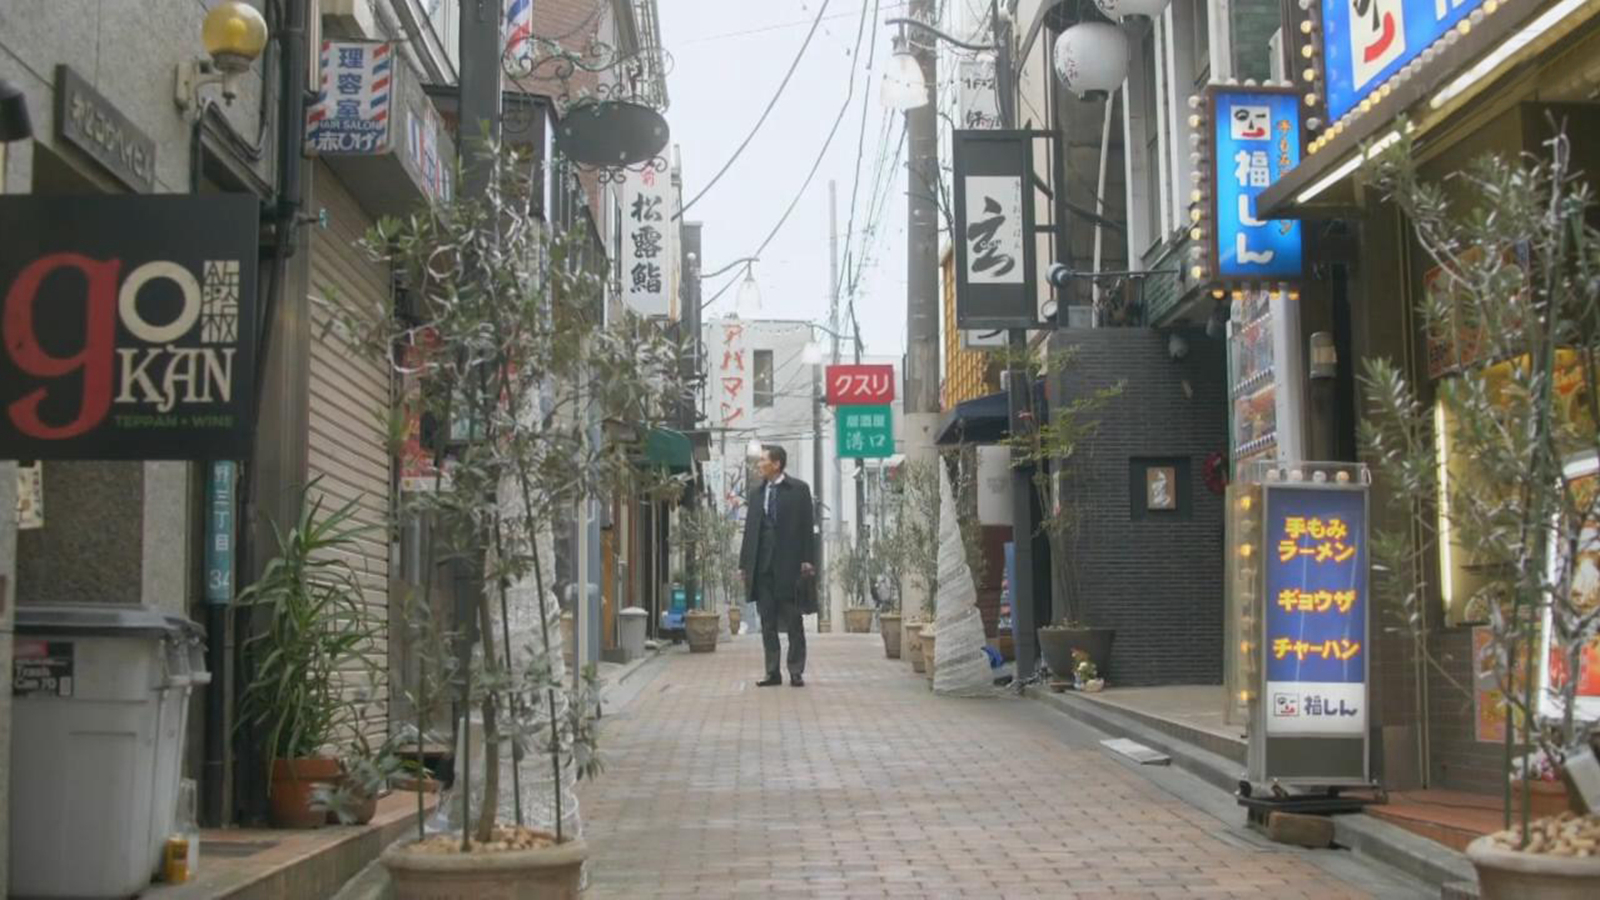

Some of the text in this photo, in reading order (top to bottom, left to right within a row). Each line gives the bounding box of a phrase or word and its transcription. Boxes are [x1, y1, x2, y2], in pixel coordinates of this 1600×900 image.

[337, 47, 364, 120] 理容室
[317, 132, 377, 151] 赤ひげ
[1234, 149, 1274, 264] 福しん
[630, 192, 663, 294] 松露鮨
[835, 374, 889, 396] クスリ
[192, 415, 234, 428] WINE
[1284, 517, 1347, 539] 手もみ
[1278, 540, 1355, 562] ラーメン
[1277, 589, 1356, 612] ギョウザ
[1272, 637, 1360, 660] チャーハン
[1304, 695, 1358, 716] 福しん
